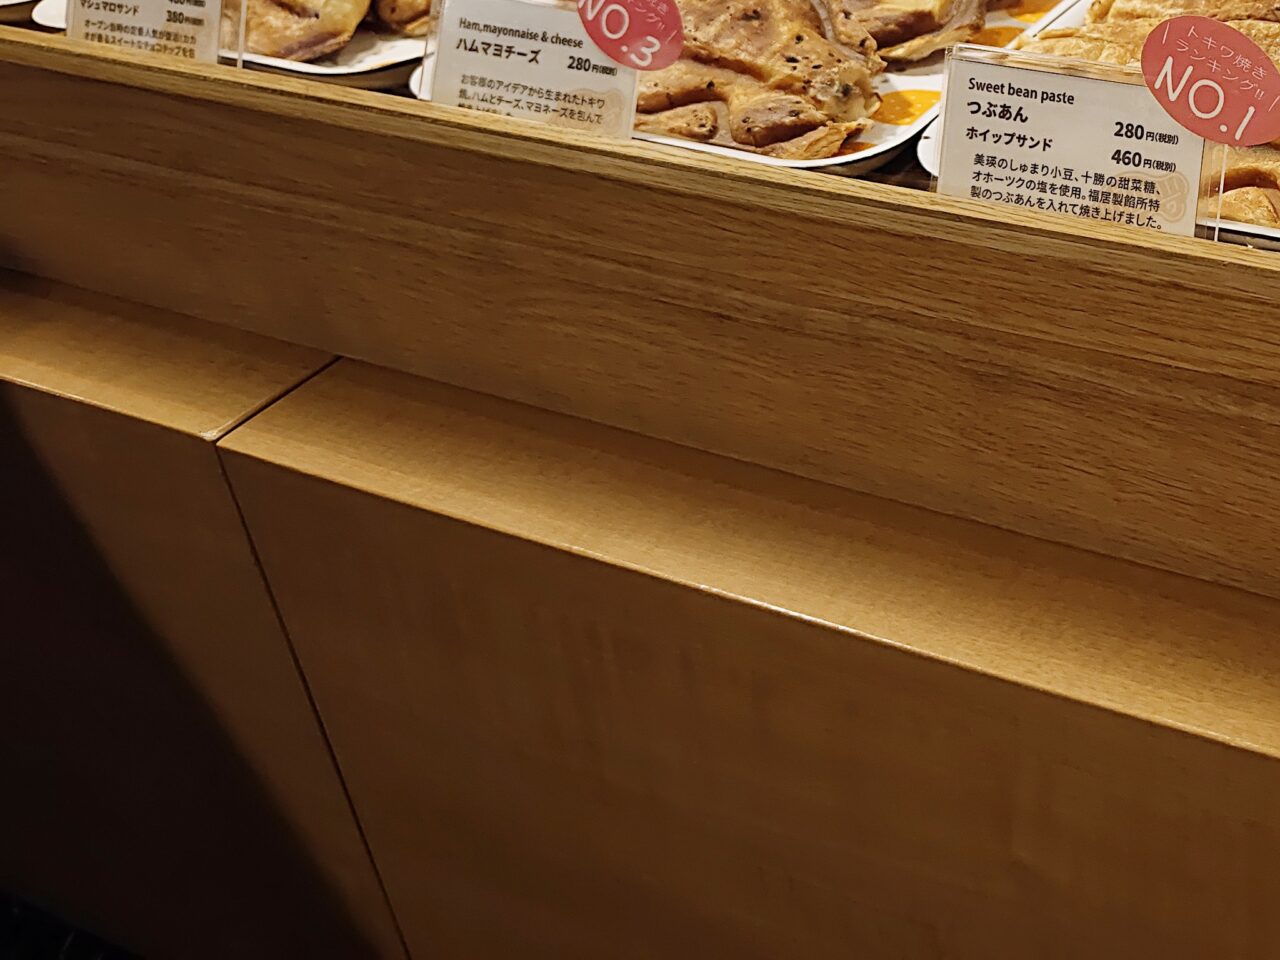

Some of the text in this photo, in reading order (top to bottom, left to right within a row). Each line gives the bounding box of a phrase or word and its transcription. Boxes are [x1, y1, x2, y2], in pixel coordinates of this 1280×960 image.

[459, 17, 584, 49] Ham,mayonnaise & cheese
[456, 38, 542, 64] ハムマヨチーズ
[1188, 25, 1267, 80] トキワ焼き
[968, 77, 1075, 105] Sweet bean paste
[1154, 56, 1256, 140] NO.1
[967, 101, 1029, 123] つぶあん
[966, 127, 1053, 152] ホイップサンド
